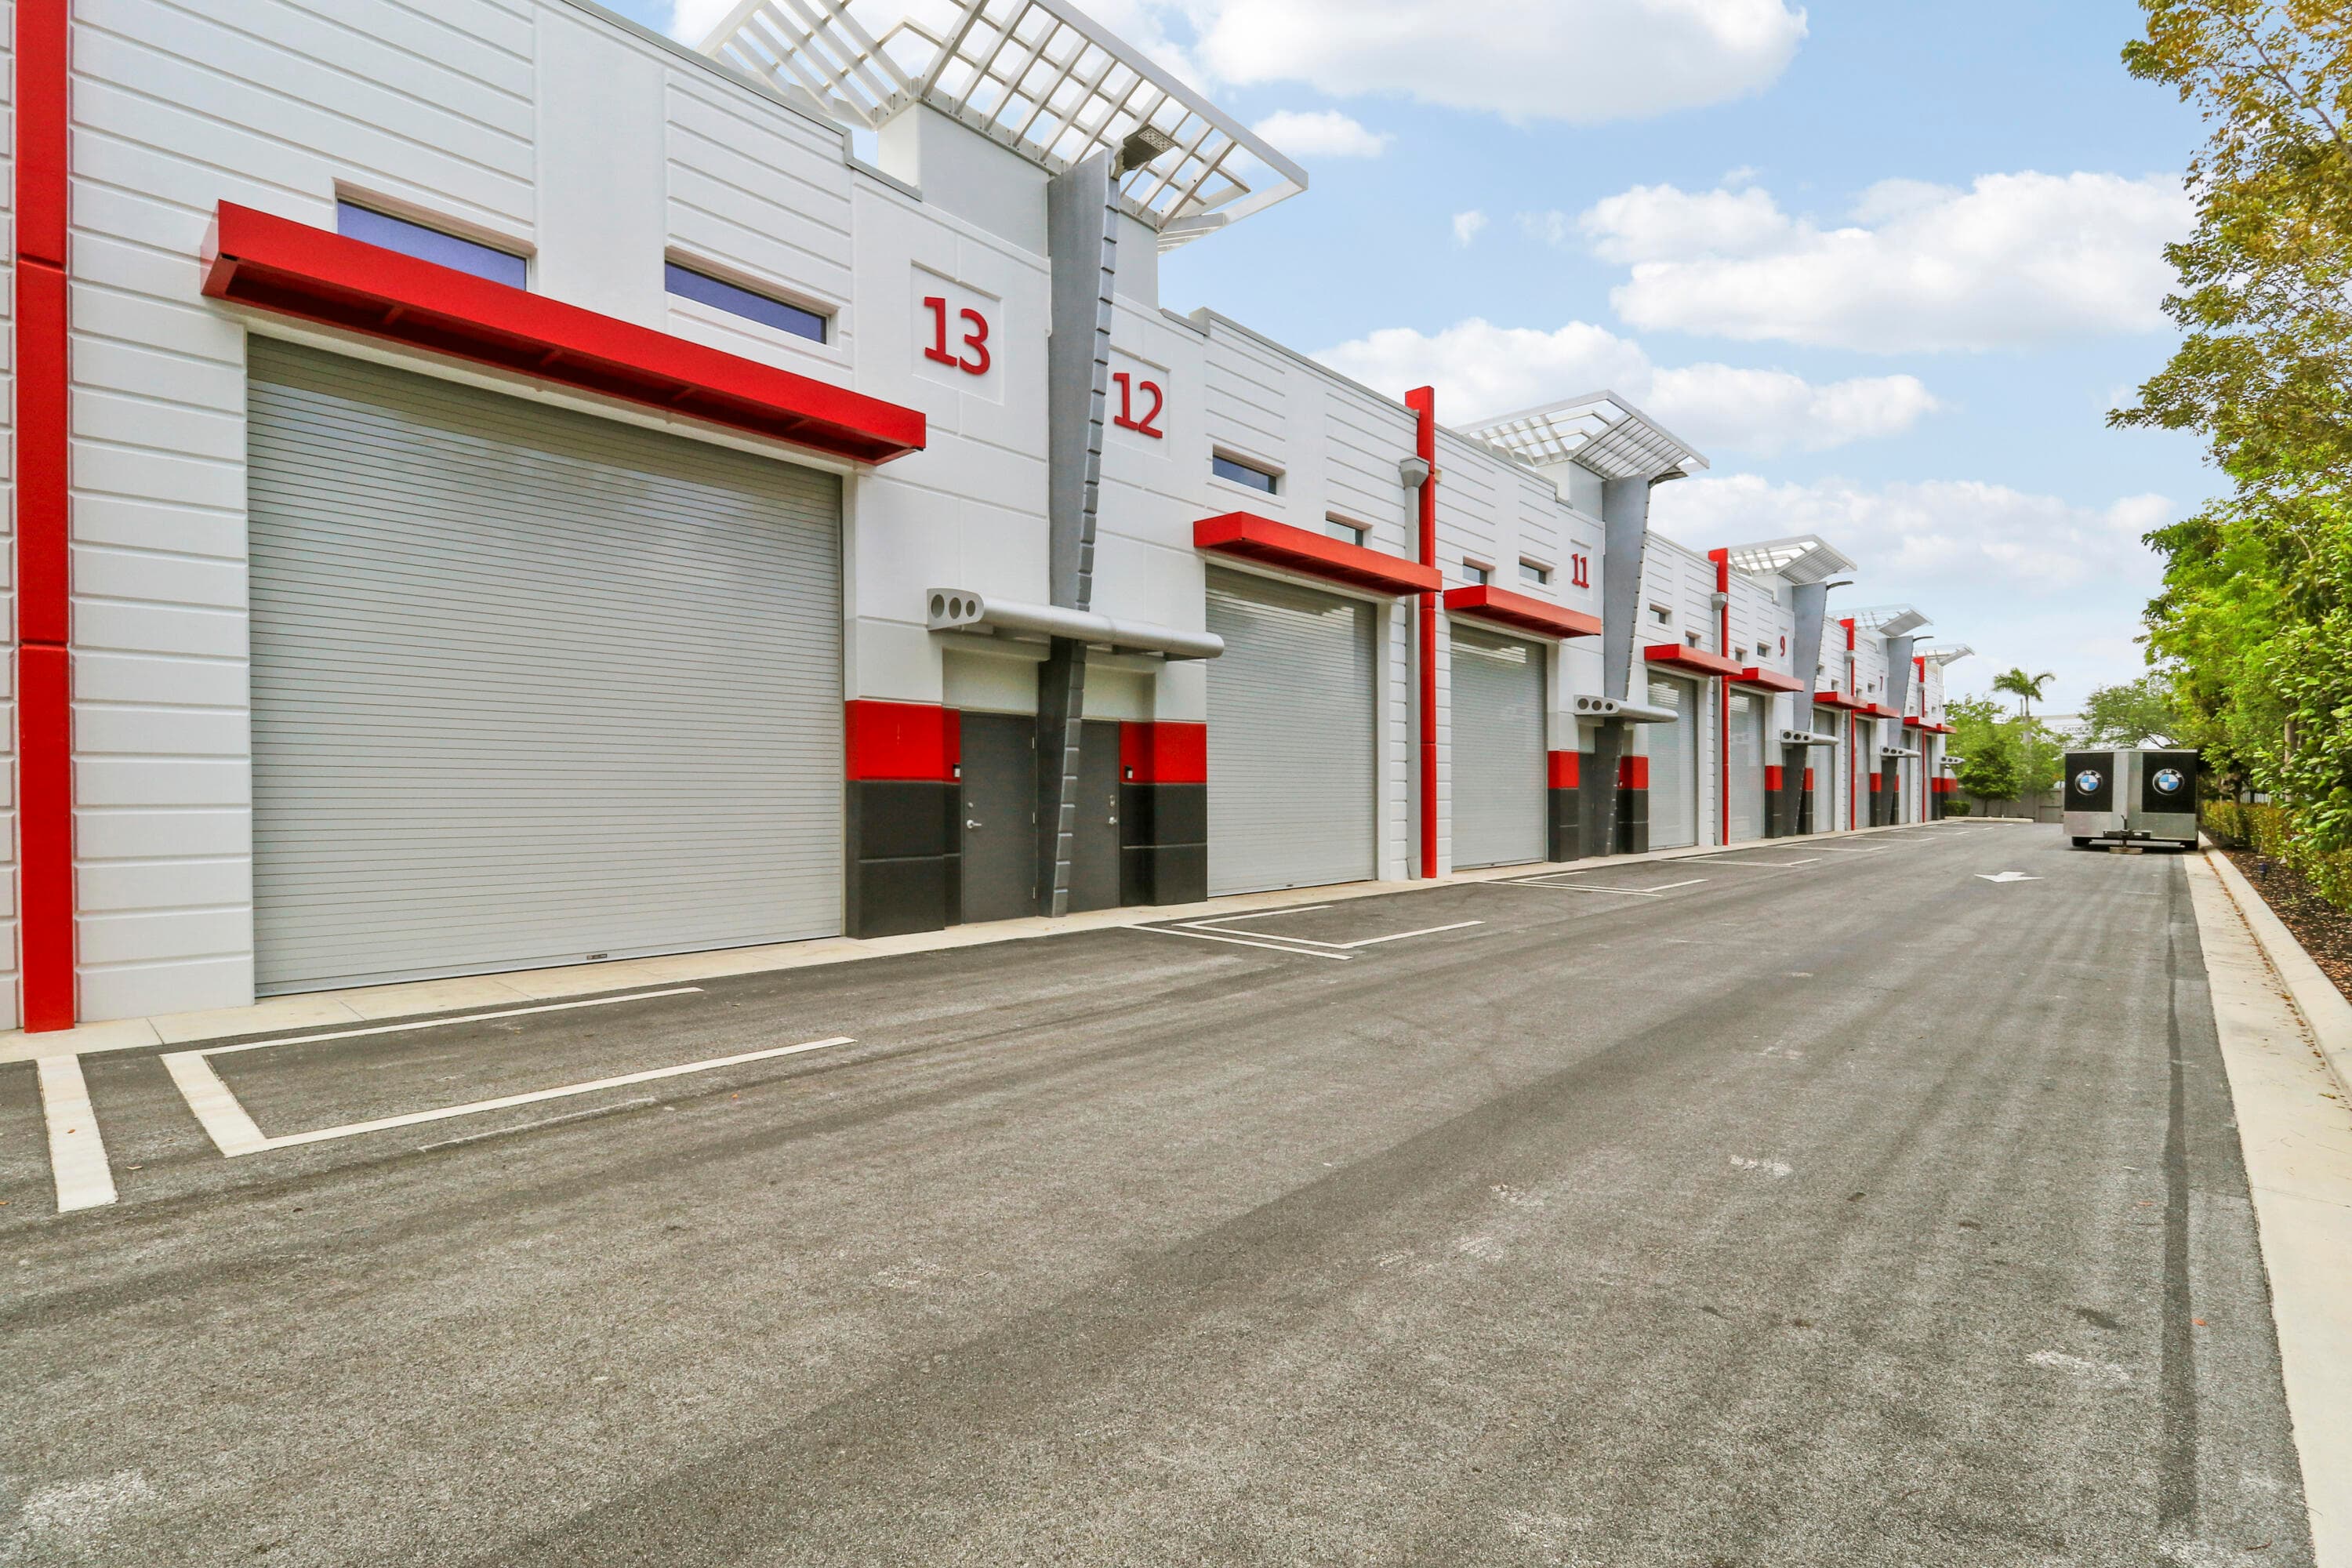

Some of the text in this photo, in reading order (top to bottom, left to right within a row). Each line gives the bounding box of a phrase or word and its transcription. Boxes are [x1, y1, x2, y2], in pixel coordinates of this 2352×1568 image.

[924, 296, 990, 376] 13
[1113, 372, 1163, 439] 12
[1571, 553, 1590, 589] 11
[1780, 635, 1786, 657] 9
[1879, 676, 1883, 691] 7
